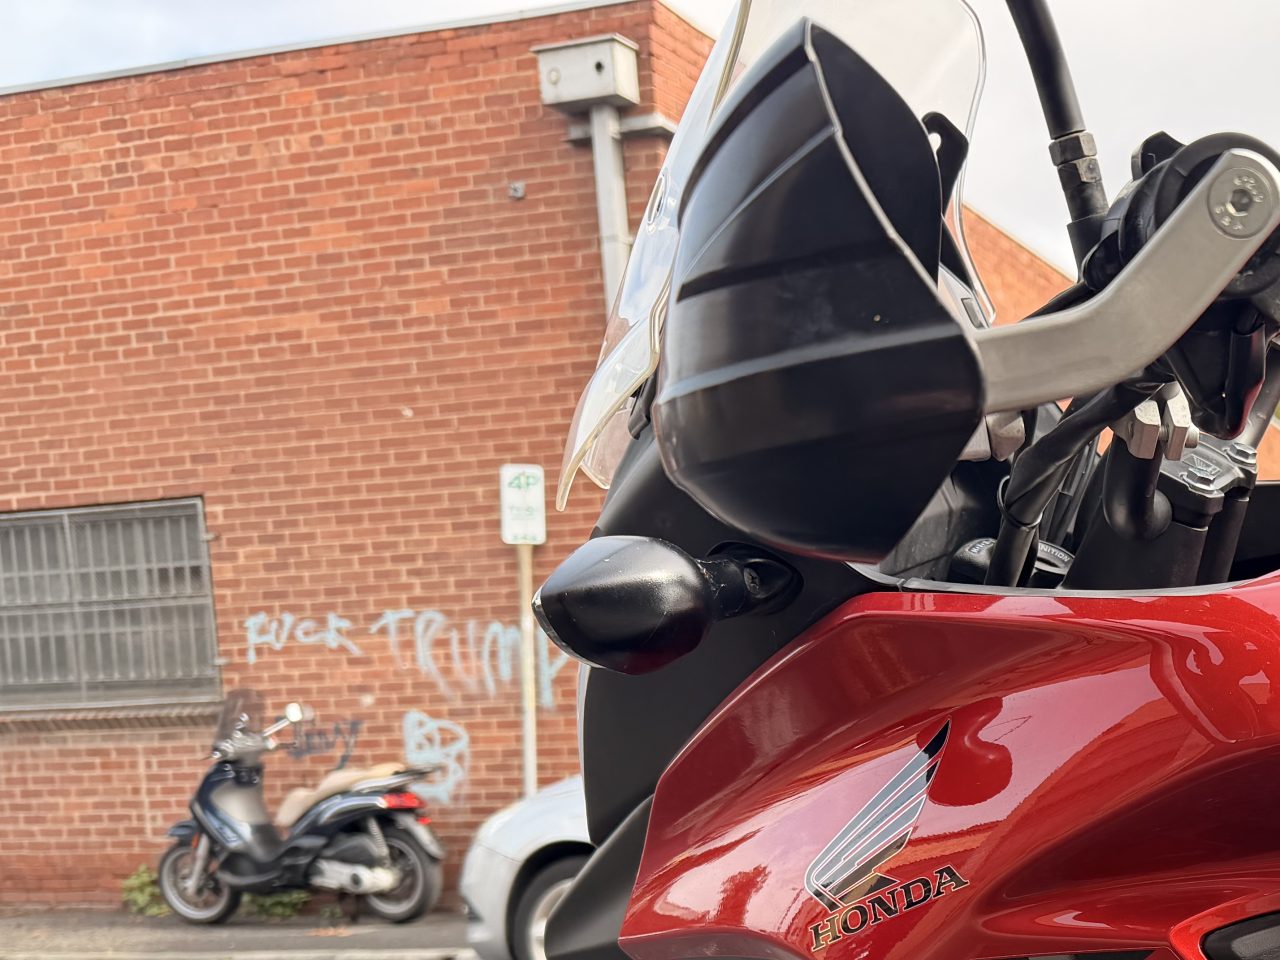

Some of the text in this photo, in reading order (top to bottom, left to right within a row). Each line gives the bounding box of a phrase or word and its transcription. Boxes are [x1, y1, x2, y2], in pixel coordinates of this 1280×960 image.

[508, 470, 541, 490] 4P
[1039, 542, 1070, 561] NITION
[244, 611, 361, 664] FUCK
[809, 864, 970, 951] HONDA
